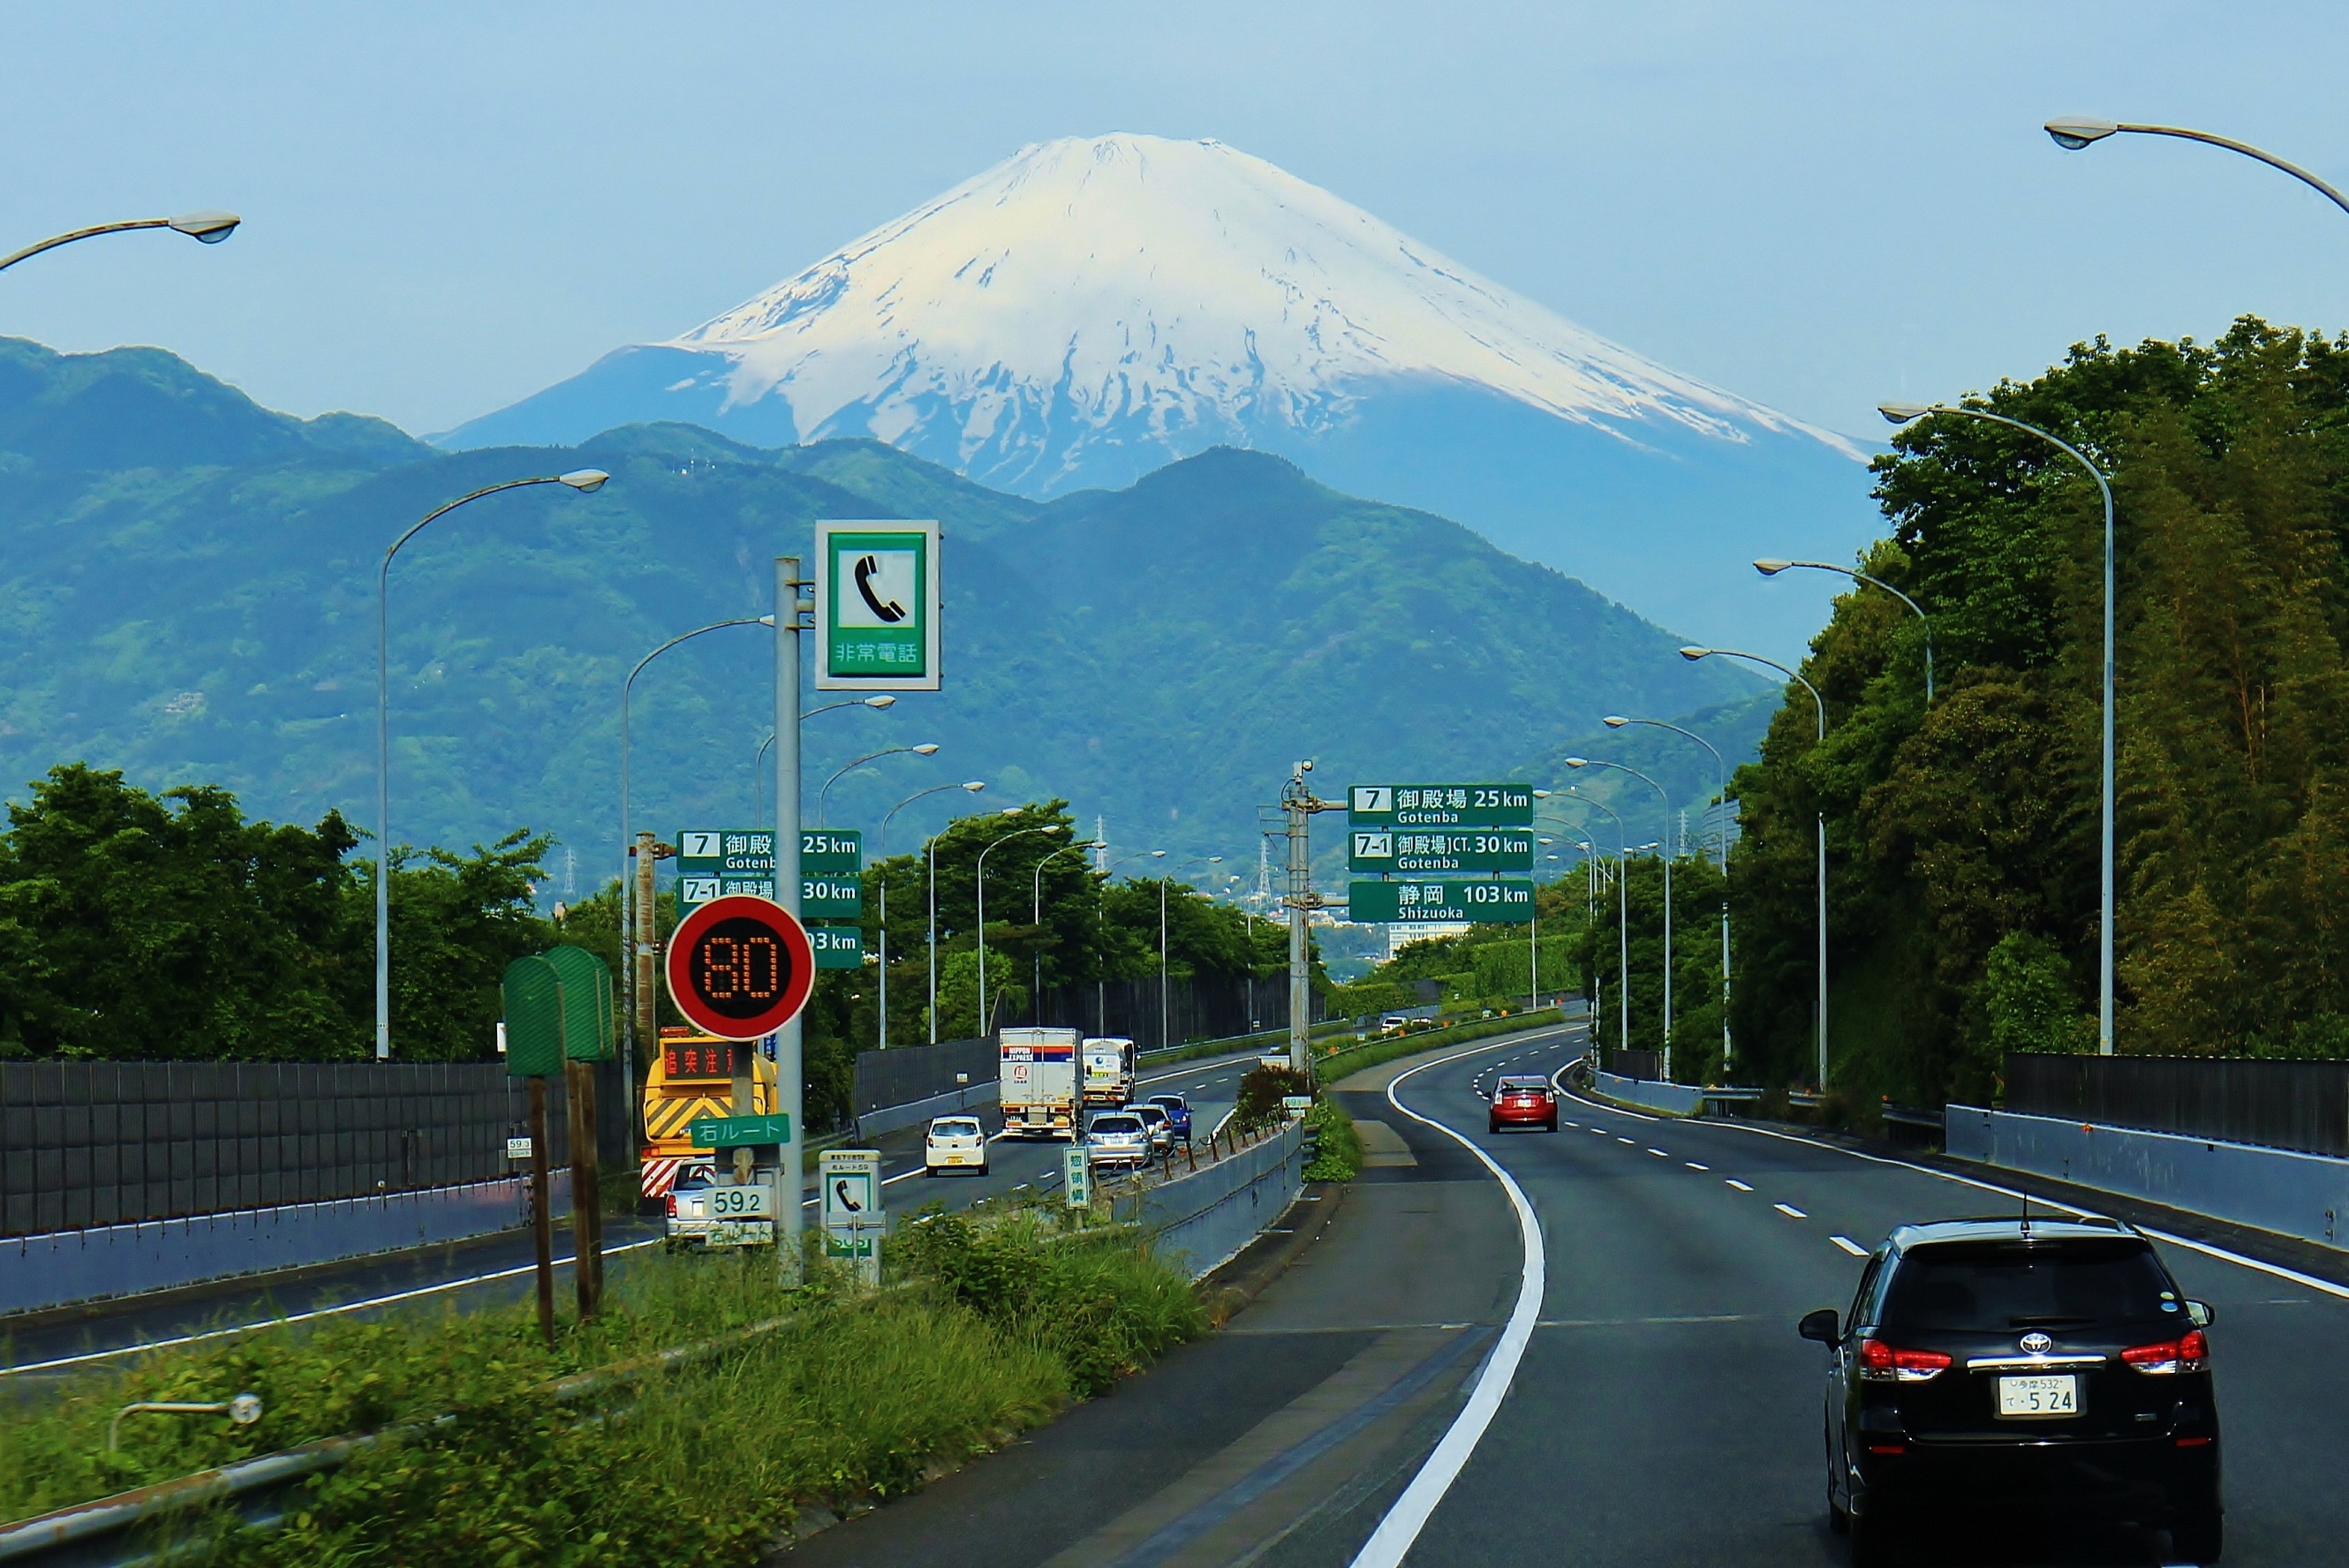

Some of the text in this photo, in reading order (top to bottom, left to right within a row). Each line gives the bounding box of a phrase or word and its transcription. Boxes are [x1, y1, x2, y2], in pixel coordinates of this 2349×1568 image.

[835, 643, 918, 662] 非常電話
[1366, 790, 1380, 809] 7
[1397, 789, 1467, 810] 御殿場
[1398, 811, 1459, 824] Gotenba
[694, 835, 708, 855] 7
[725, 834, 776, 855] 御殿
[1358, 836, 1387, 855] 7-1
[726, 856, 776, 869] Gotenb
[1398, 857, 1459, 870] Gotenba
[686, 881, 716, 900] 7-1
[1398, 885, 1444, 905] 静岡
[1398, 907, 1463, 919] Shizuoka
[704, 937, 777, 999] 80
[714, 1191, 760, 1213] 59.2
